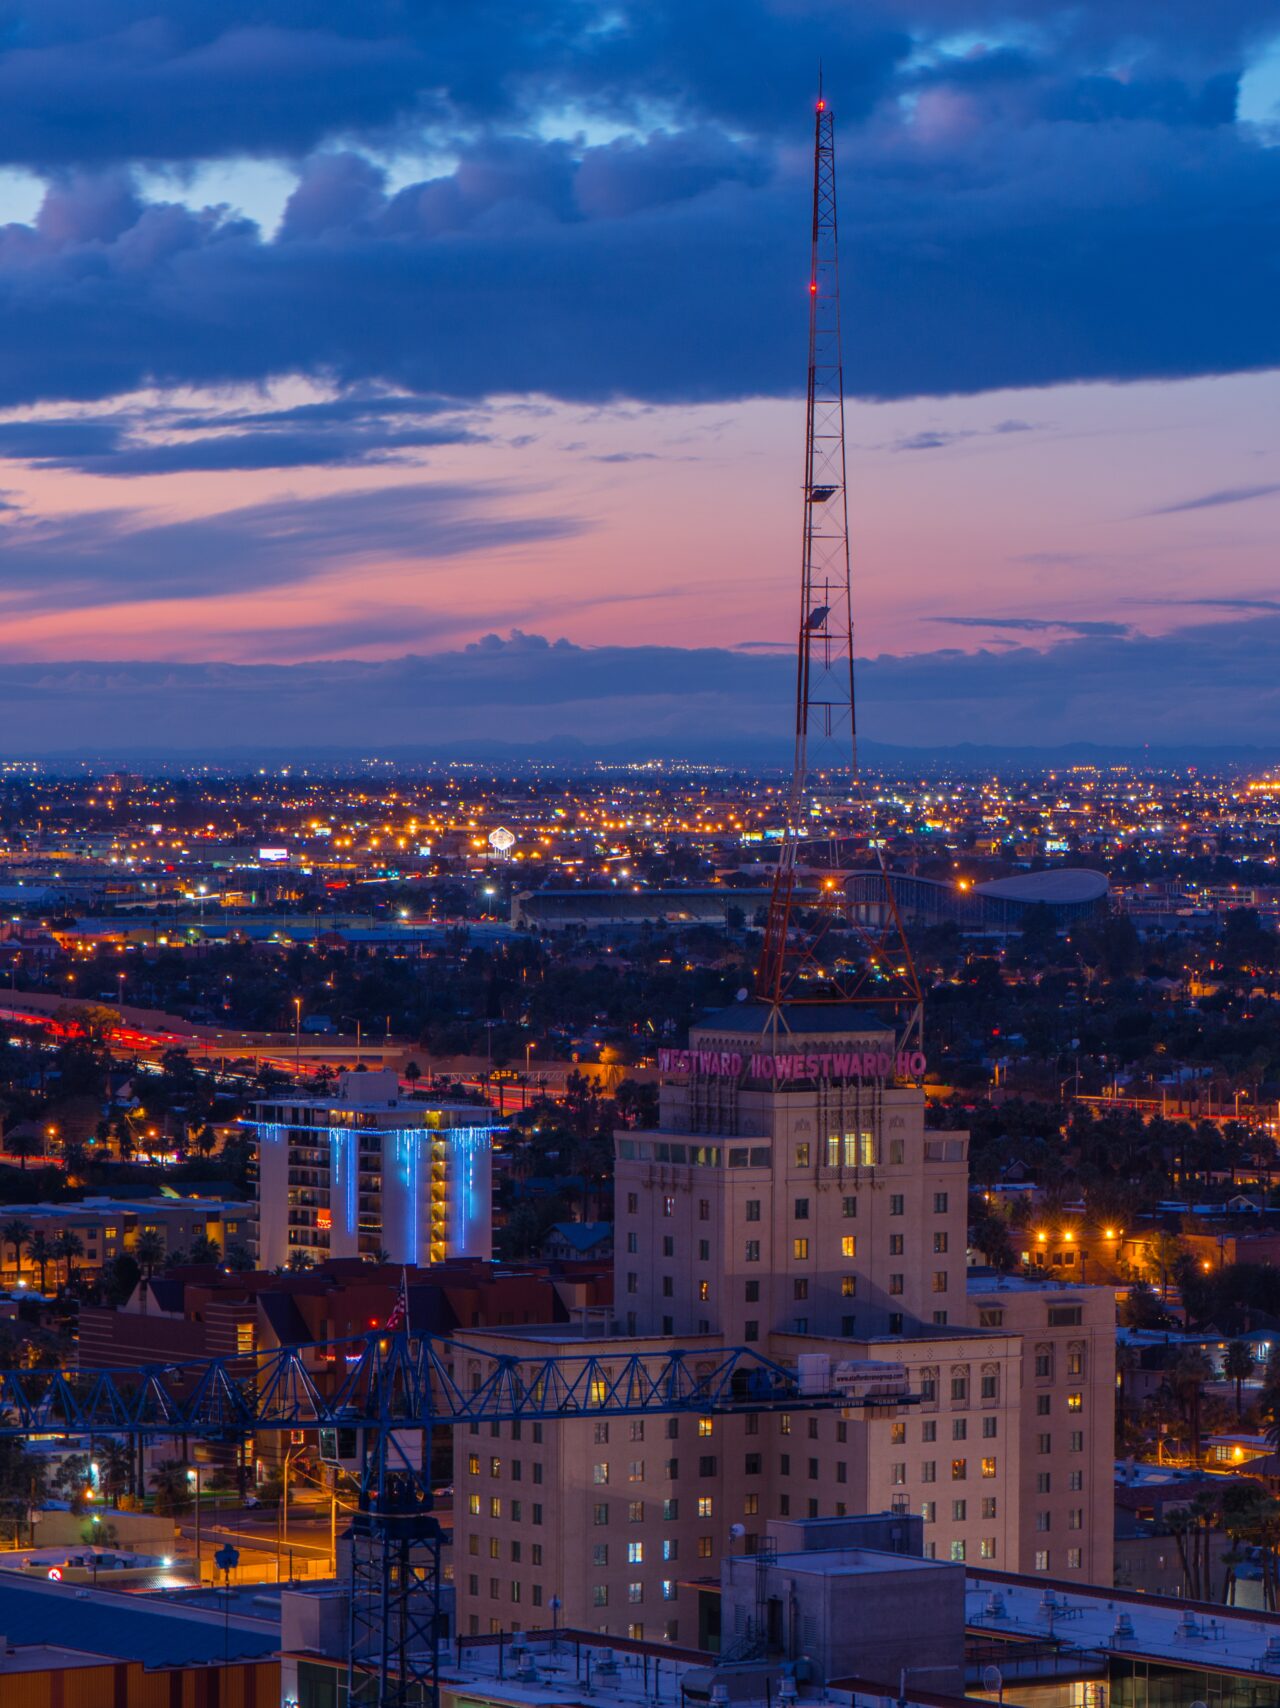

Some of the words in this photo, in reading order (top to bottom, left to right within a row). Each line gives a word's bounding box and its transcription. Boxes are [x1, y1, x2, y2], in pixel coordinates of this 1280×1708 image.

[658, 1048, 742, 1076] WESTWARD
[775, 1052, 891, 1079] WESTWARD
[897, 1052, 927, 1075] HO
